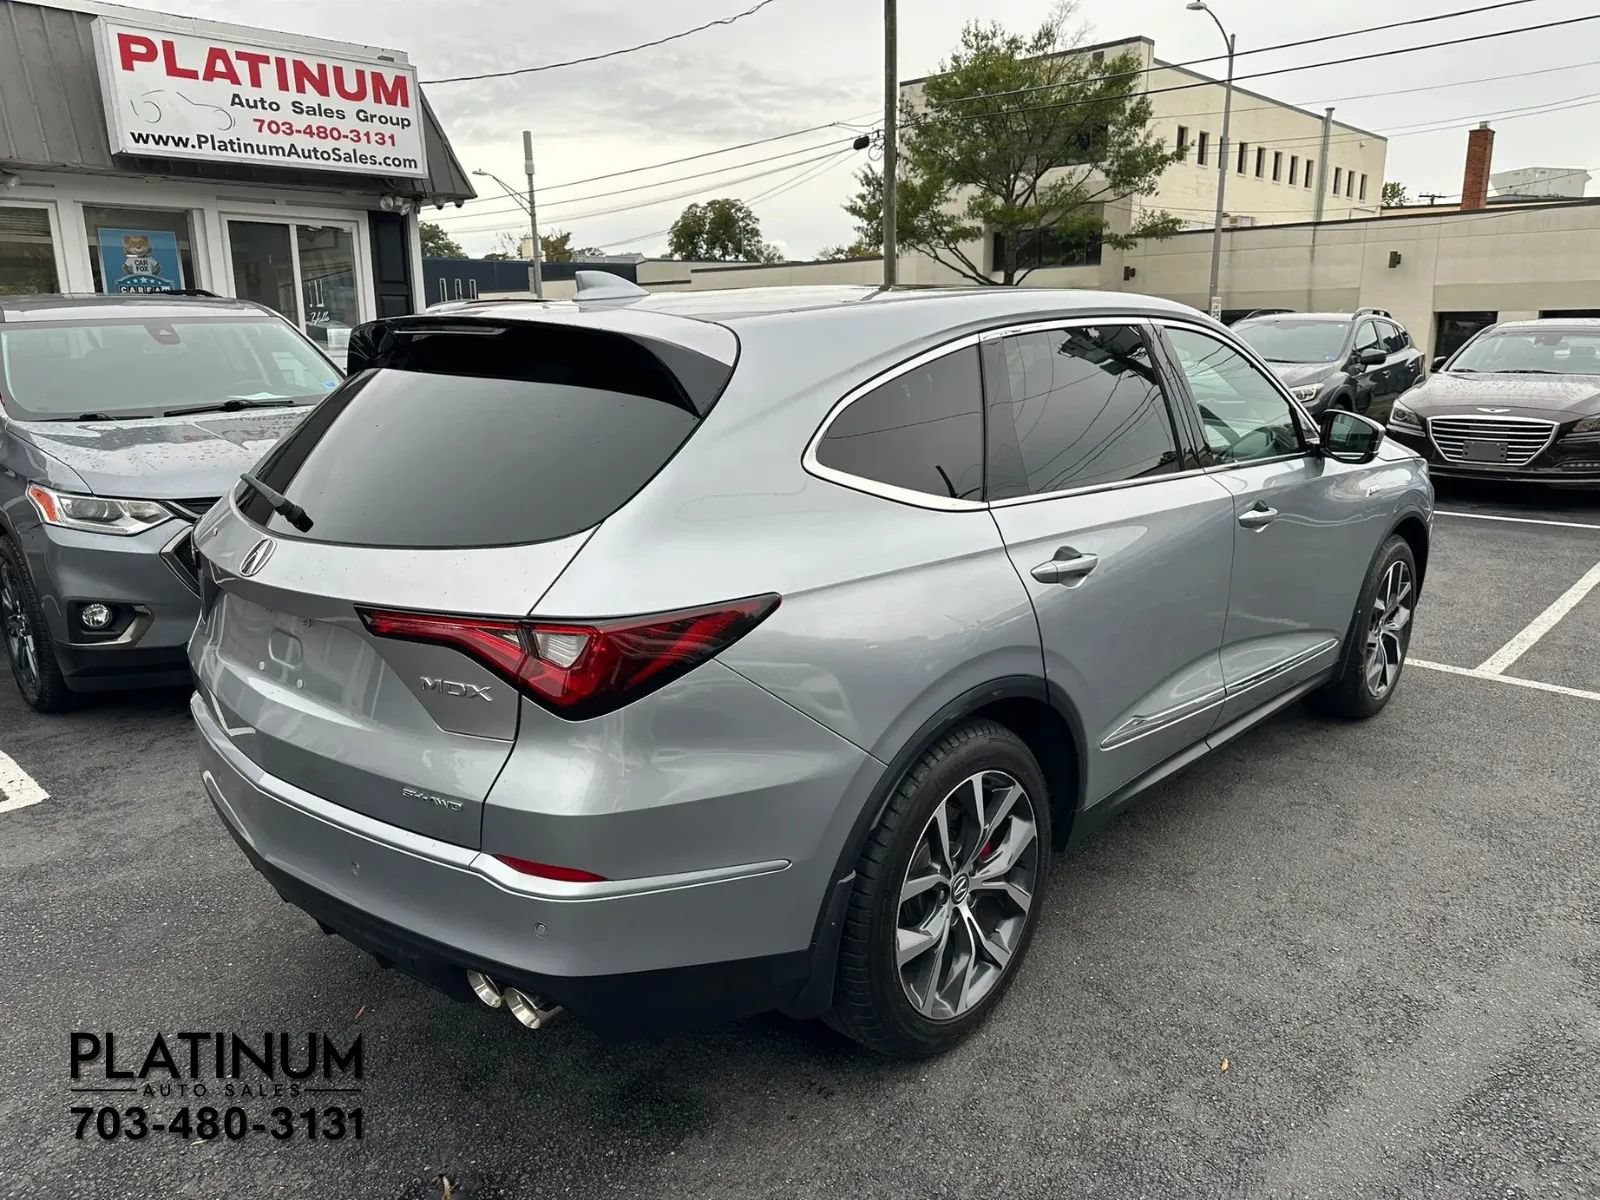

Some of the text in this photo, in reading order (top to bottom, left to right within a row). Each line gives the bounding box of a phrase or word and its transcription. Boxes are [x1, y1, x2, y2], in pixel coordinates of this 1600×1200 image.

[117, 33, 410, 108] PLATINUM
[230, 93, 411, 130] Auto Sales Group
[130, 131, 418, 170] www.PlatinumAutoSales.com
[253, 118, 396, 147] 703-480-3131
[420, 676, 492, 702] MDX
